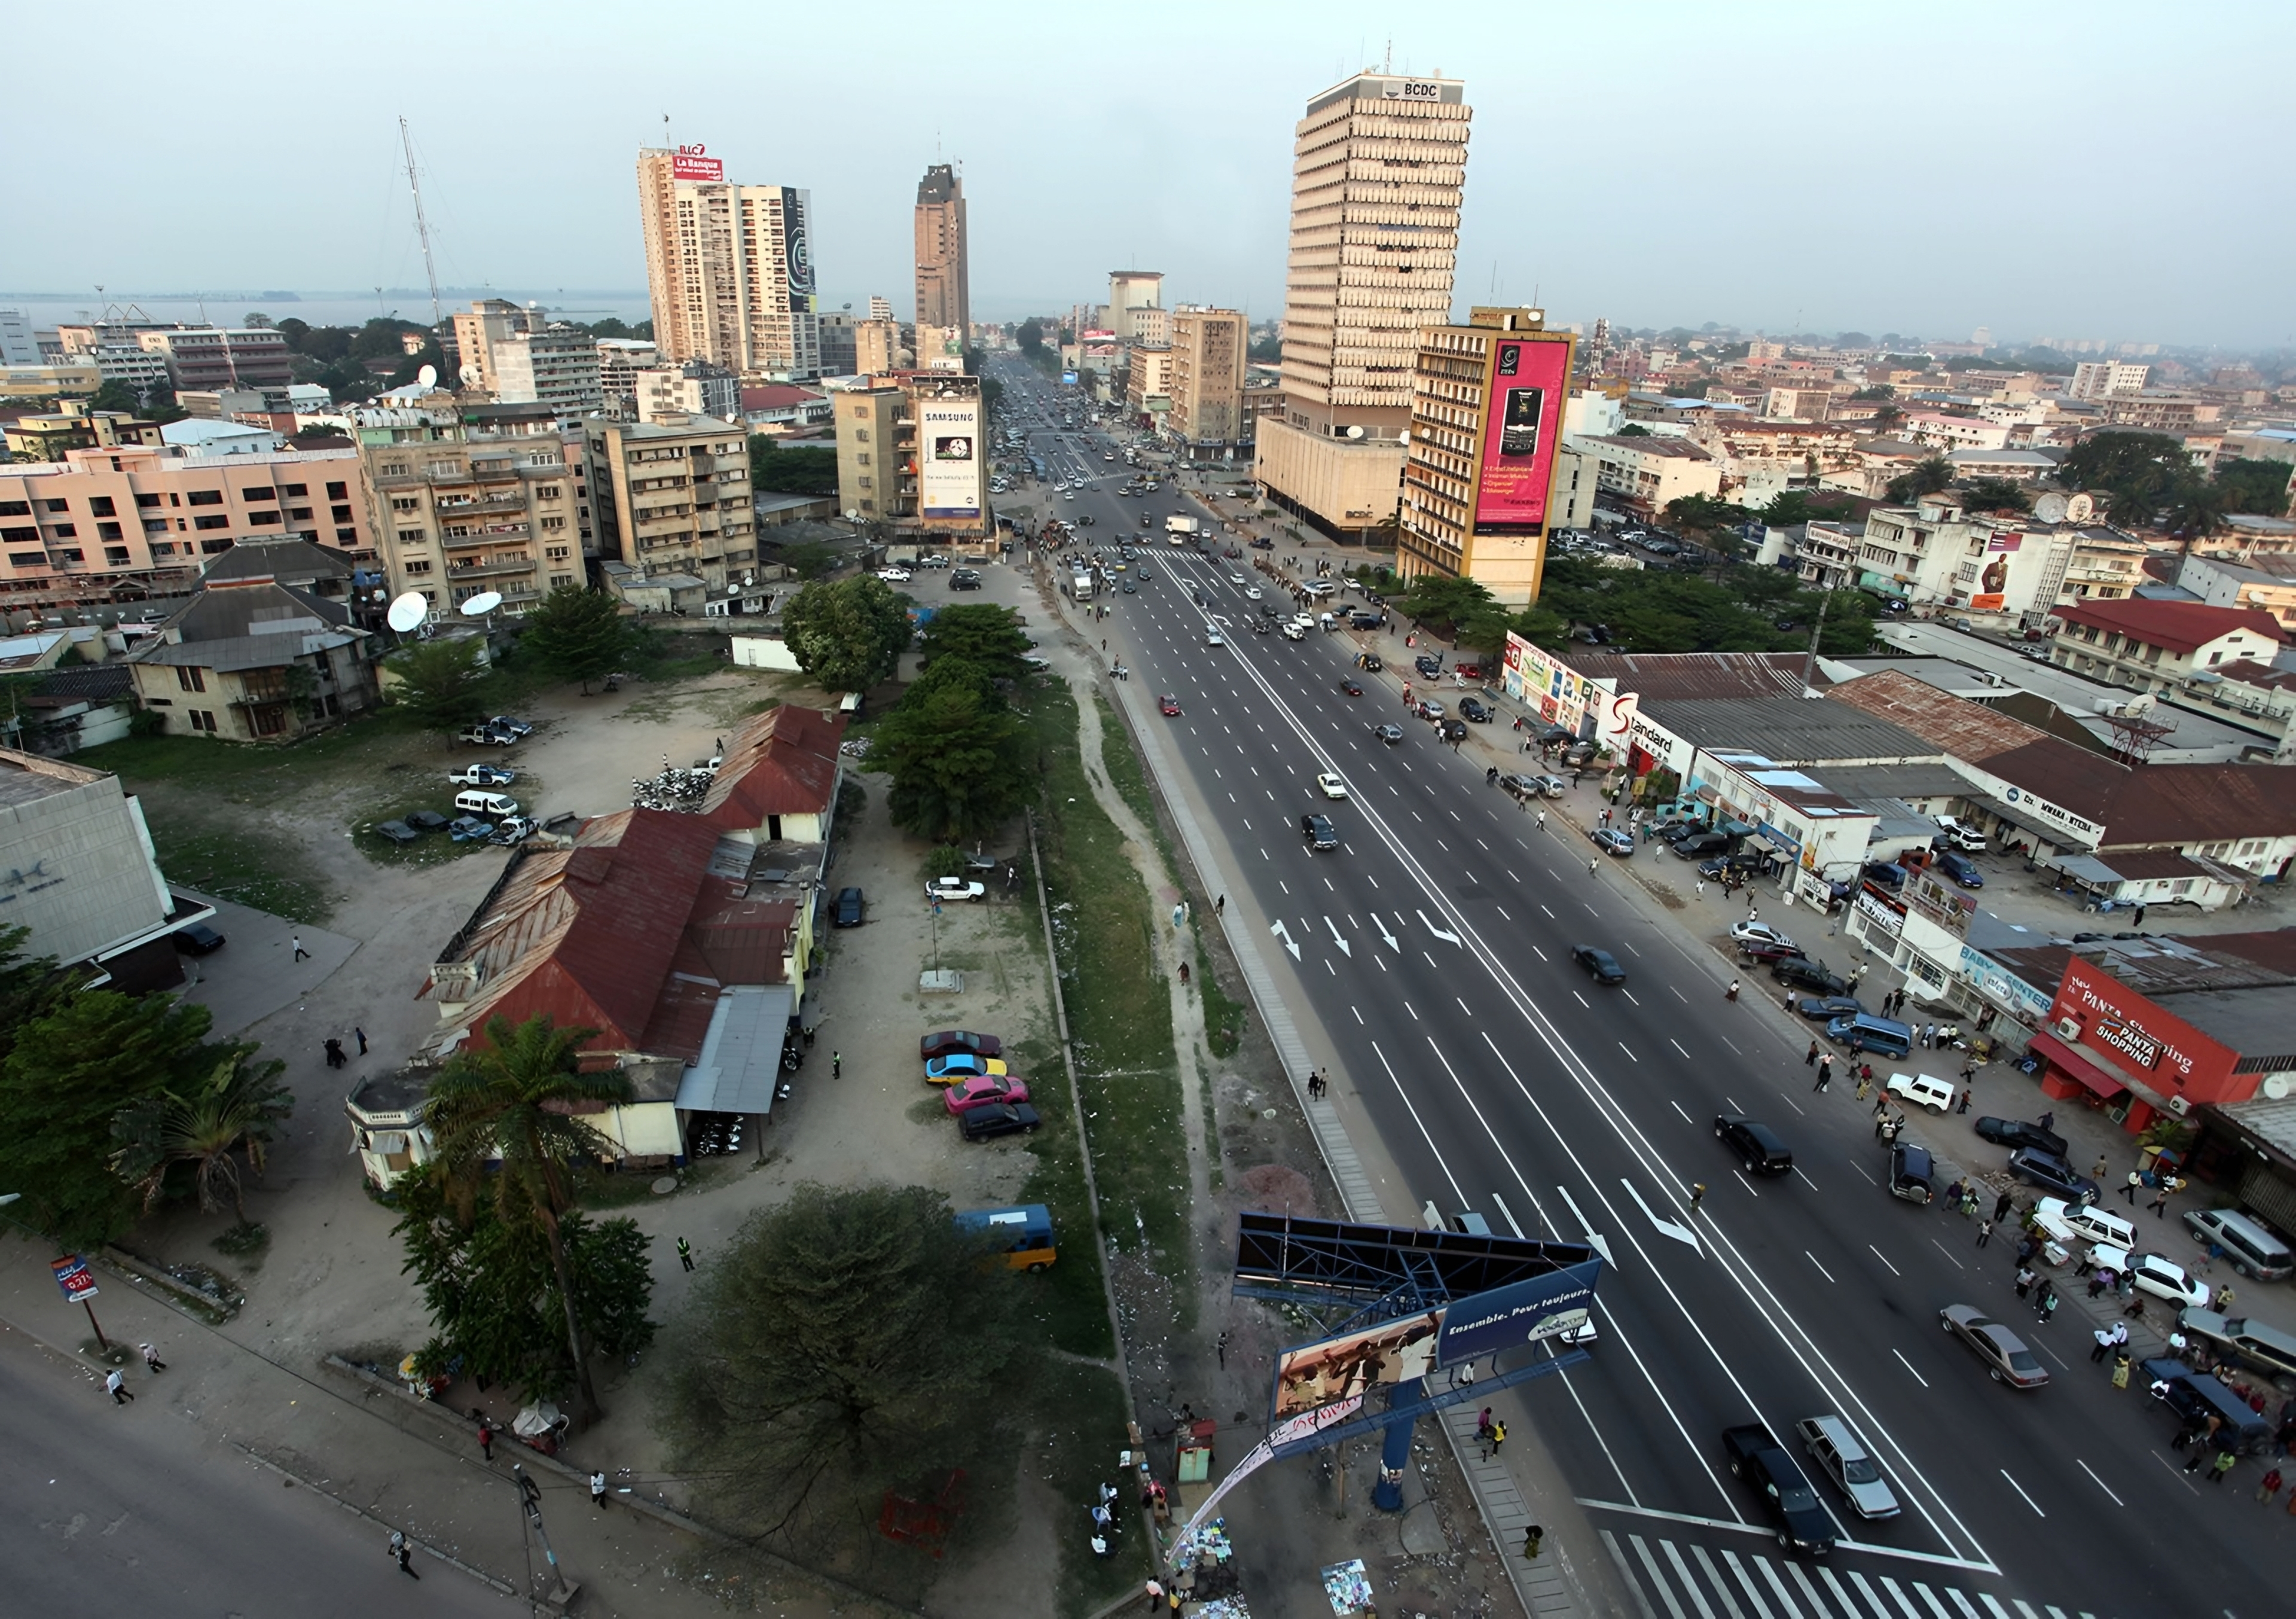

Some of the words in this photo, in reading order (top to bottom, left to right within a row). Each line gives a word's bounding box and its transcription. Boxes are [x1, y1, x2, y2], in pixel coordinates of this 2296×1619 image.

[1405, 83, 1437, 96] BCDC
[2005, 974, 2052, 1013] CENTER
[2096, 1025, 2151, 1067] SHOPPING
[2119, 1027, 2155, 1057] PANTA
[1449, 1314, 1508, 1336] Ensemble.
